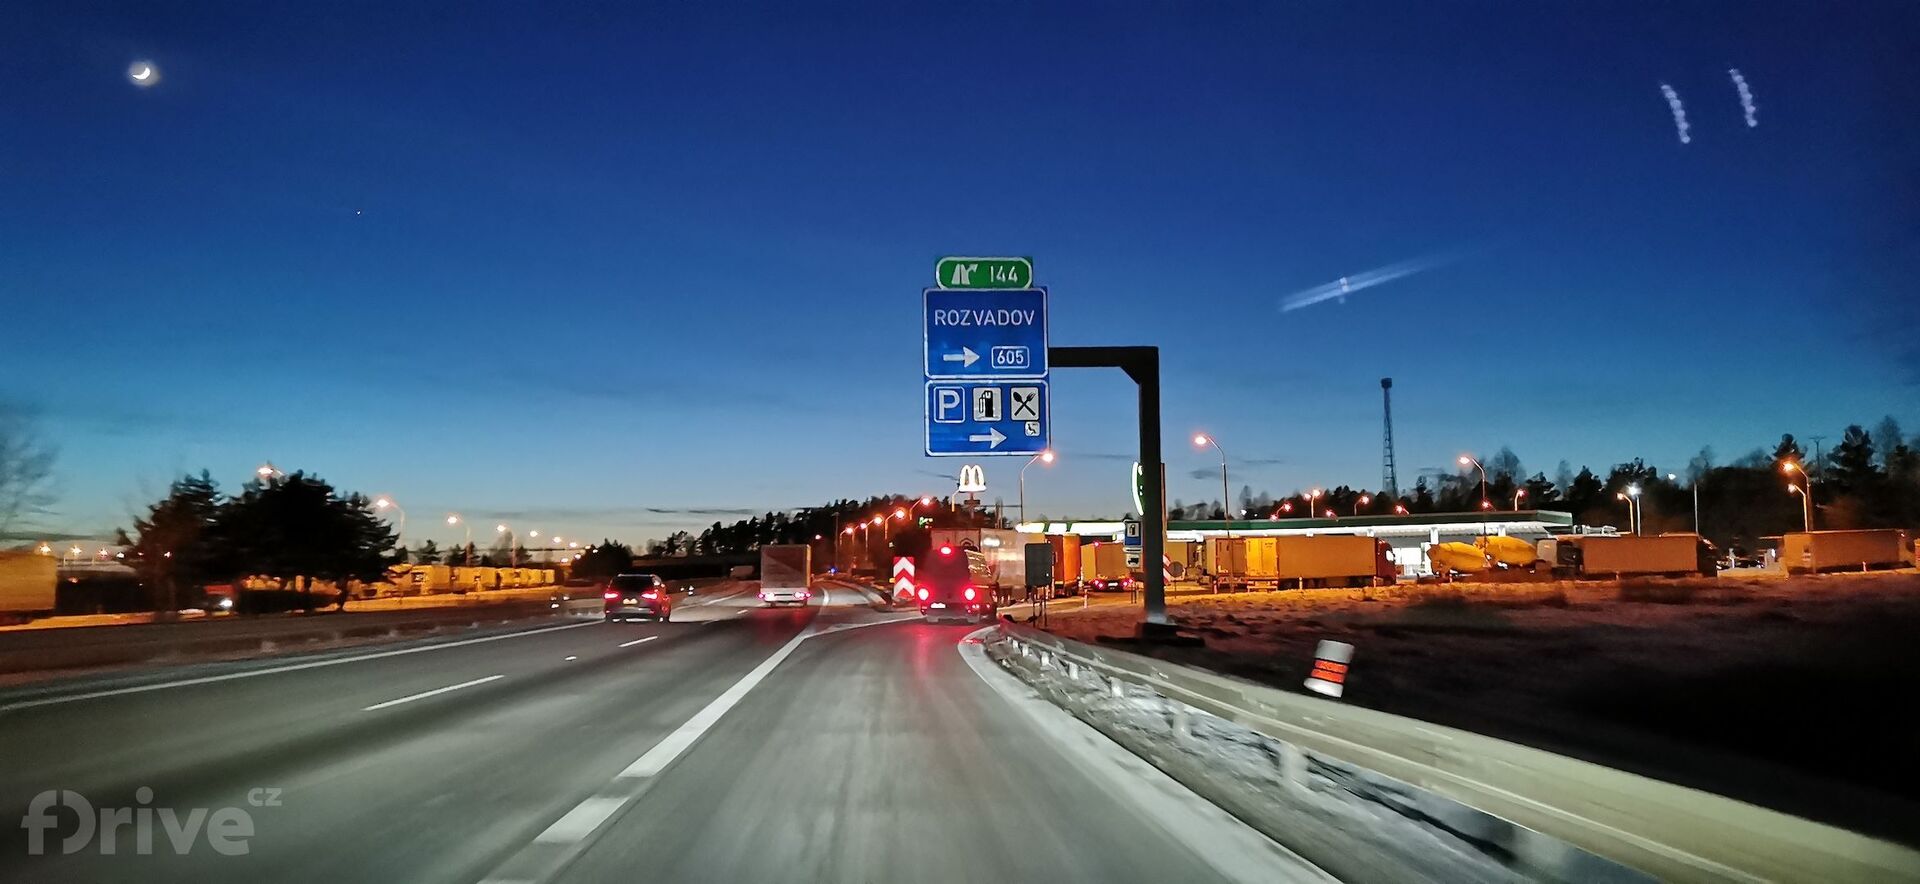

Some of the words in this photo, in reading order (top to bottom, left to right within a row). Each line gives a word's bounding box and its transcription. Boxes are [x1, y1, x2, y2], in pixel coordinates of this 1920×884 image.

[990, 265, 1018, 283] 144
[934, 309, 1035, 326] ROZVADOV
[997, 350, 1024, 365] 605
[938, 389, 960, 420] P
